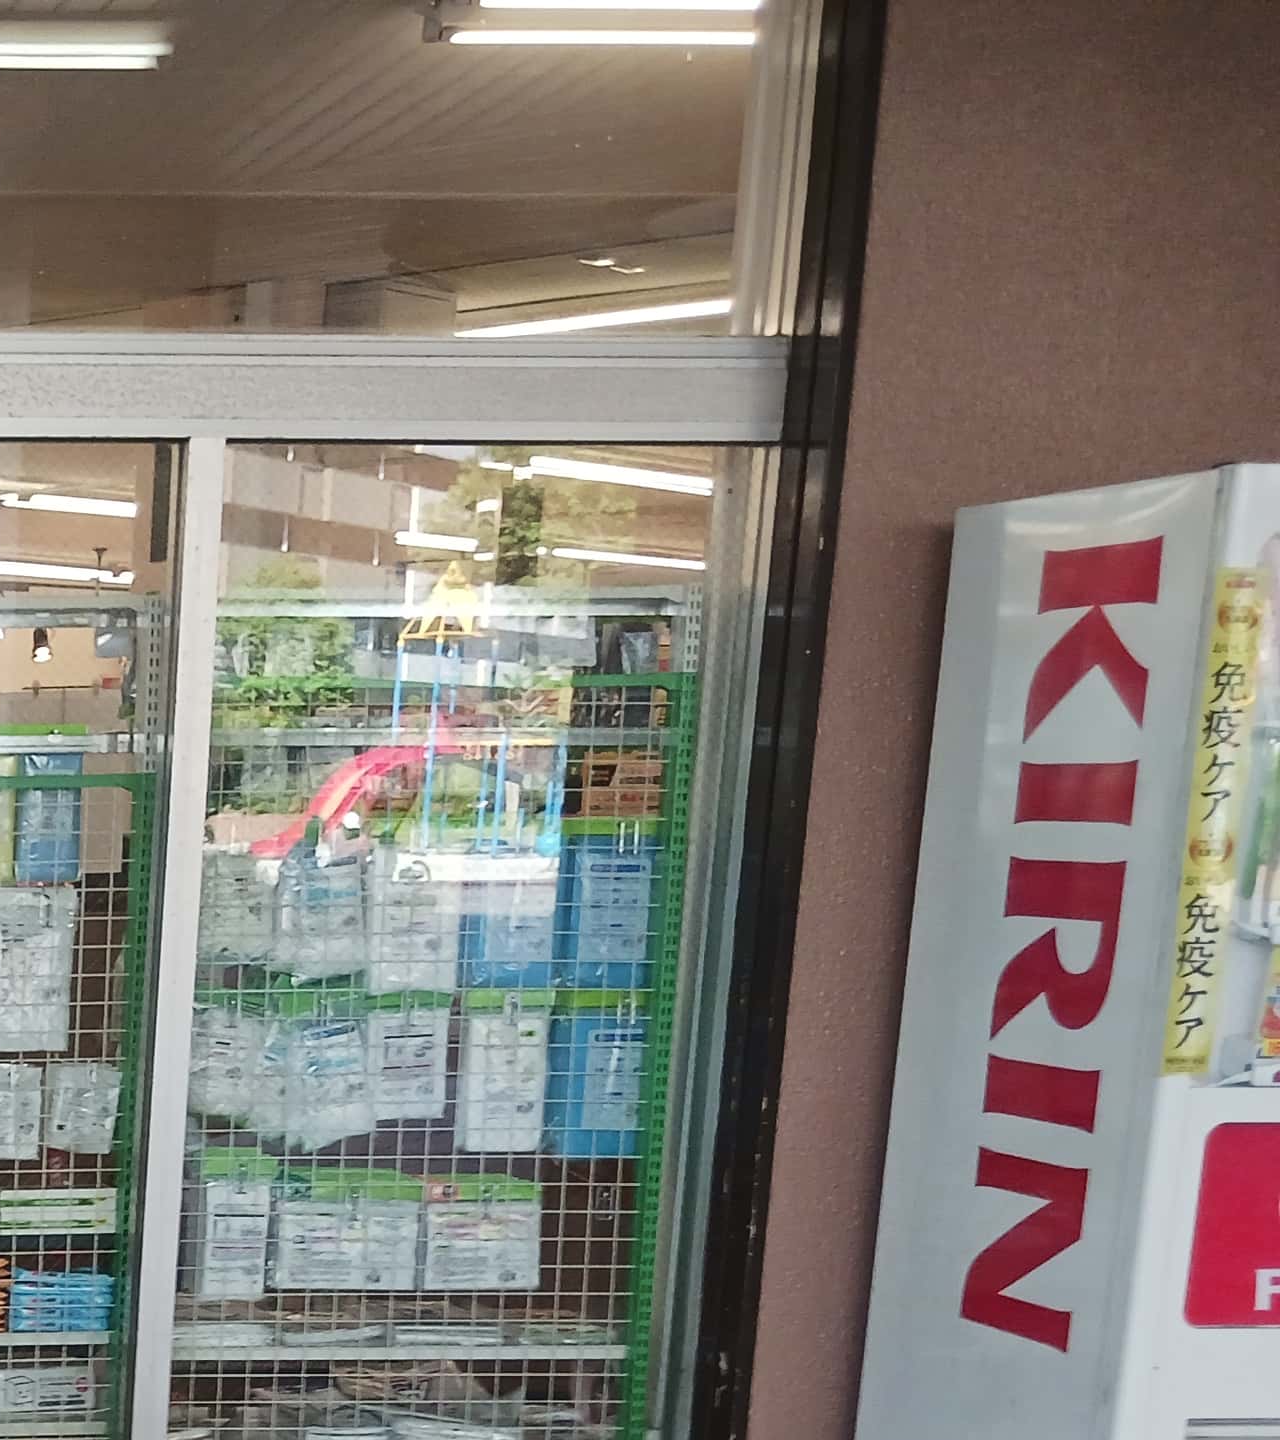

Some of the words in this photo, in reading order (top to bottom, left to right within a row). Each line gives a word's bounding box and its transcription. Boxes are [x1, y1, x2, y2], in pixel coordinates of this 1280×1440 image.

[1201, 661, 1246, 822] 免疫ケア
[960, 535, 1164, 1353] KIRIN
[1175, 893, 1220, 1049] 免疫ケア
